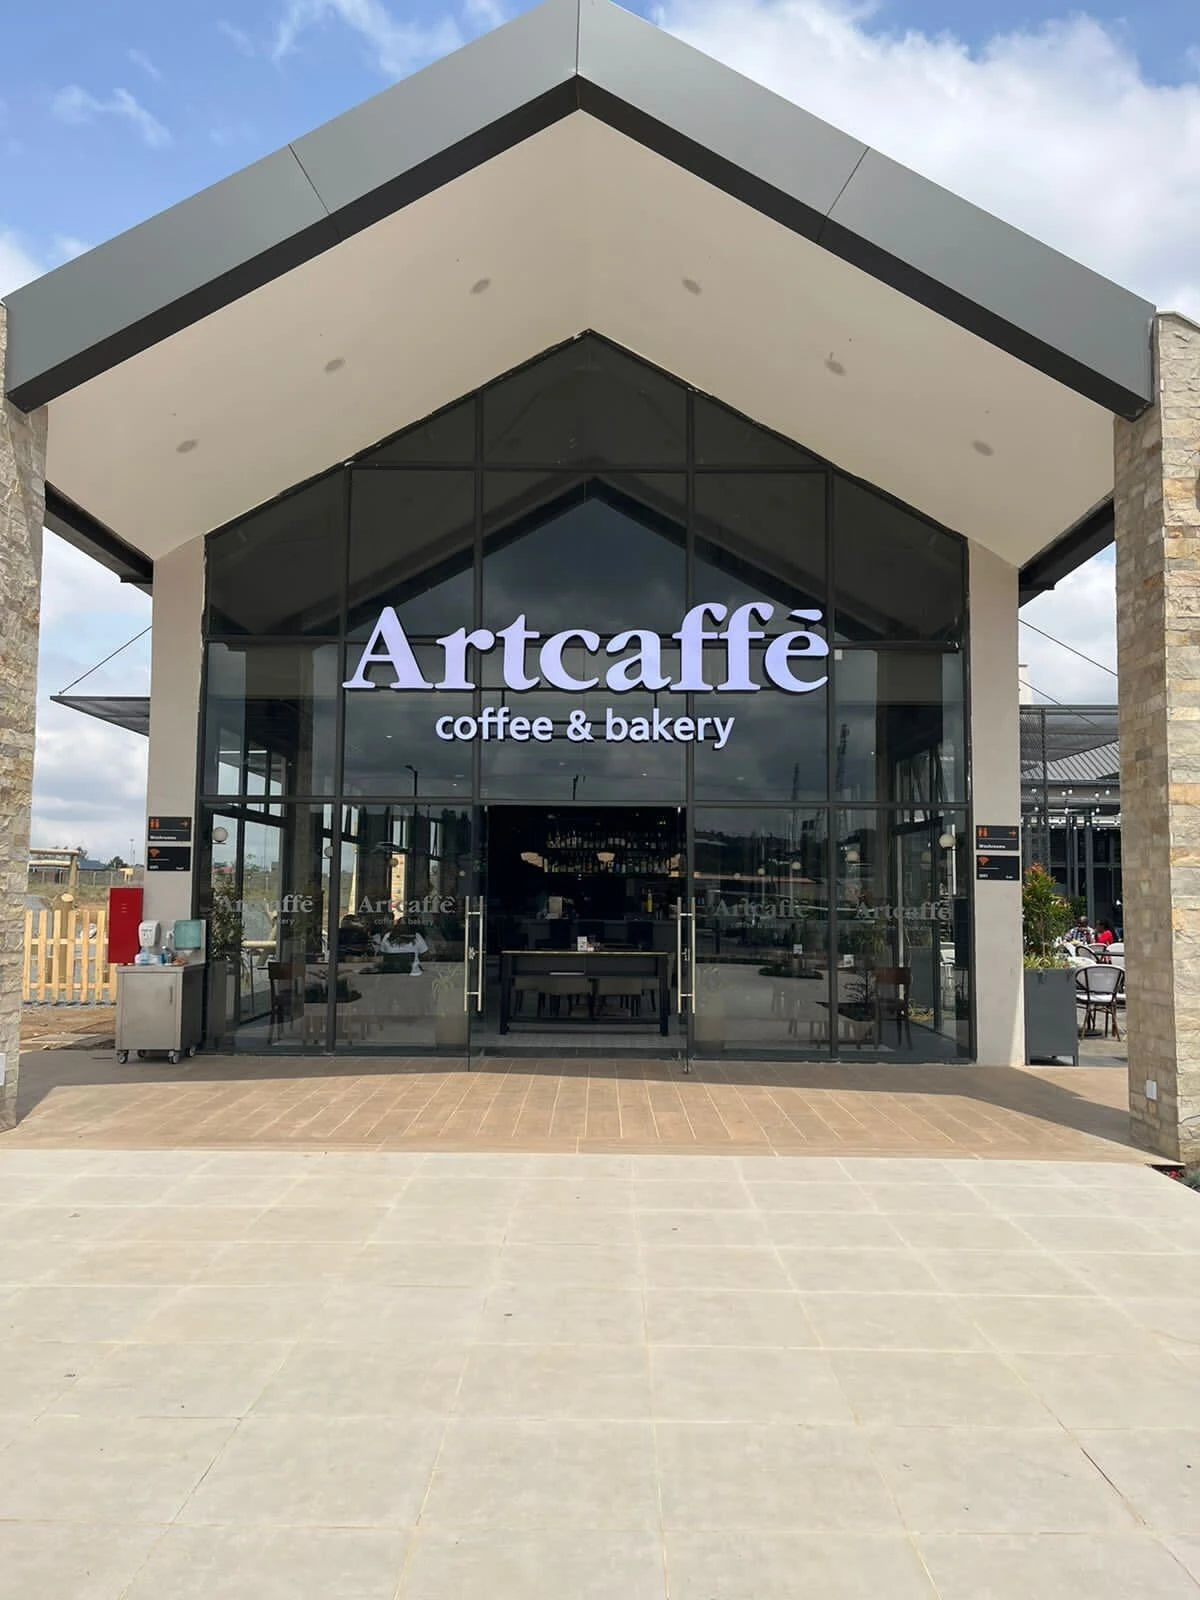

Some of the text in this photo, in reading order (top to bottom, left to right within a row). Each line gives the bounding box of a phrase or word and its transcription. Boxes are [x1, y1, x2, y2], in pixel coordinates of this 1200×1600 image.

[342, 602, 829, 692] Artcaffé
[435, 707, 736, 749] coffee & bakery
